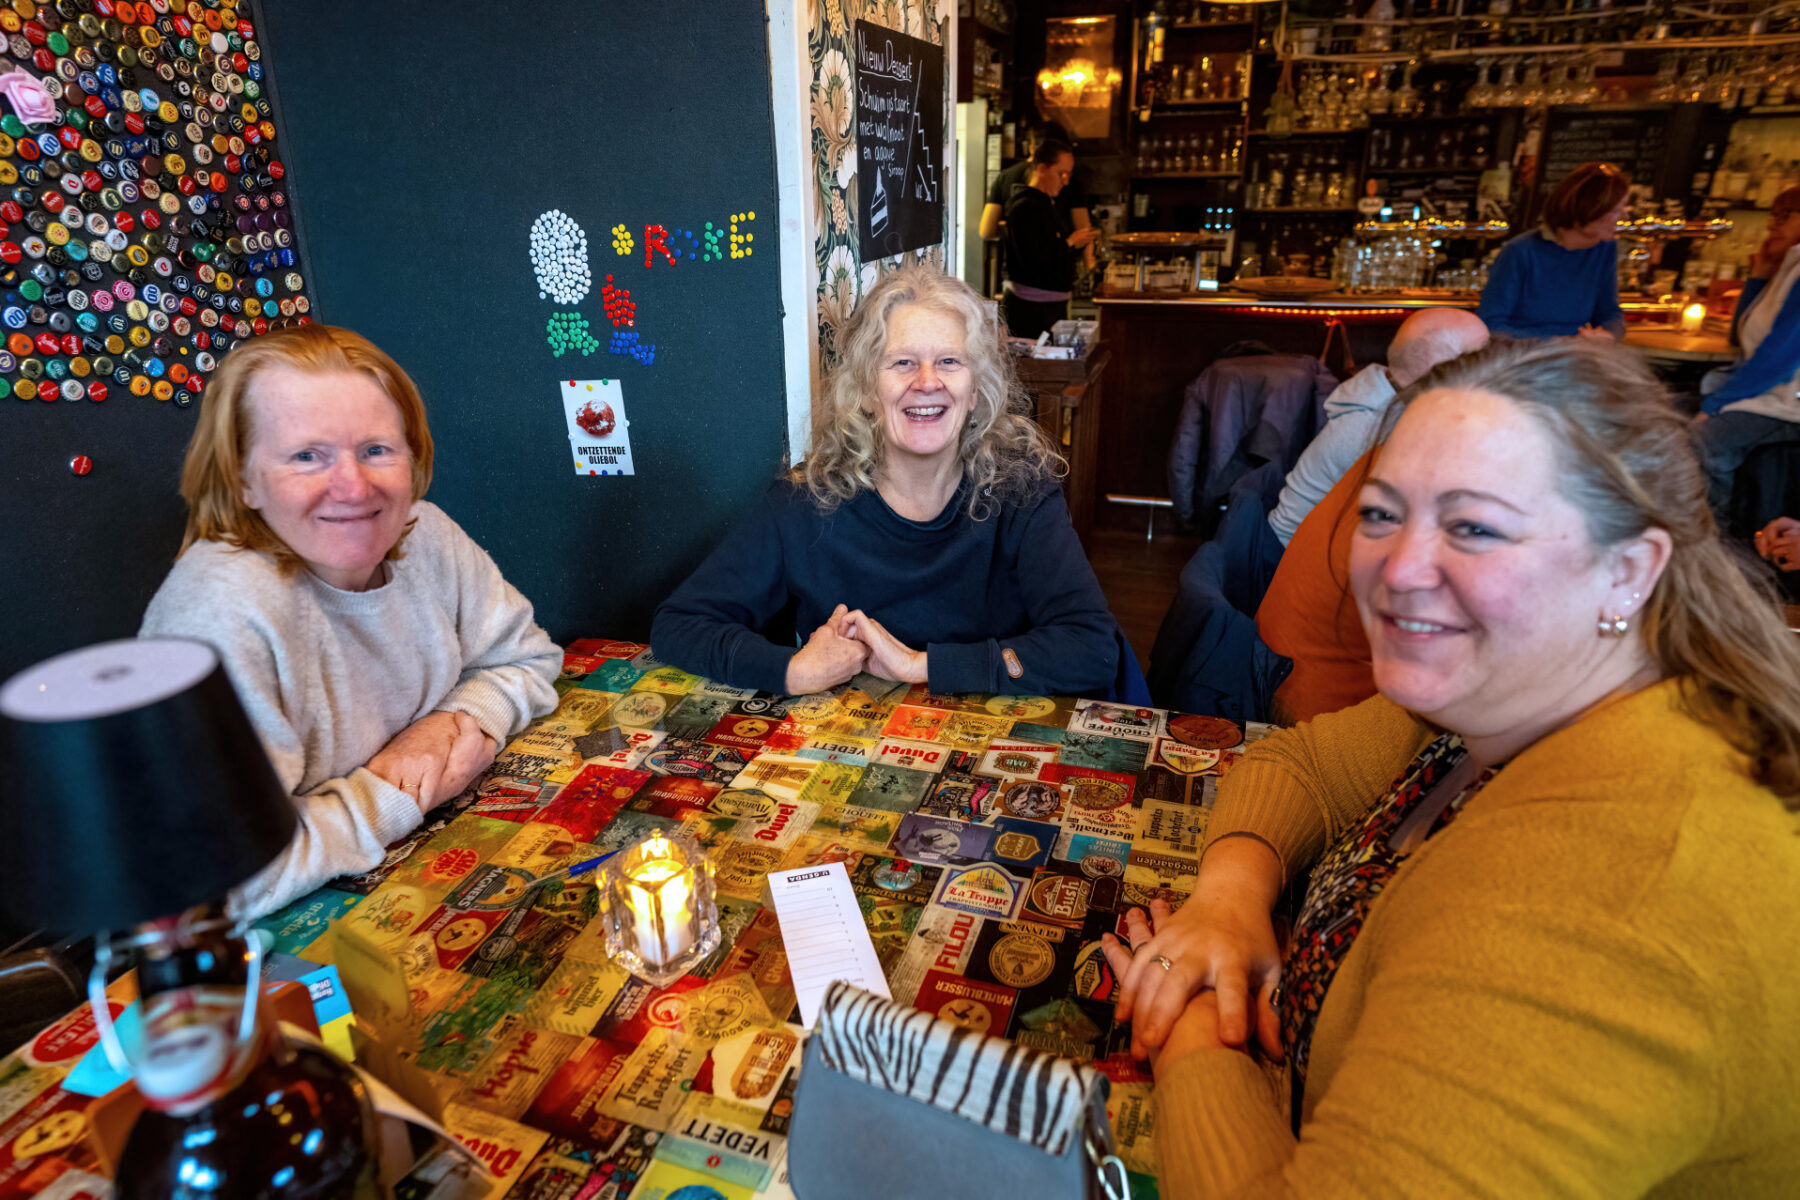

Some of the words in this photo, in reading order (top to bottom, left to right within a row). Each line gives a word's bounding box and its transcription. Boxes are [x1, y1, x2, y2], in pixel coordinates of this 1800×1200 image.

[858, 28, 884, 73] Nieuw
[885, 39, 912, 80] Dessert
[859, 115, 875, 136] met
[875, 118, 905, 143] walnoot
[863, 146, 872, 161] en
[874, 146, 896, 170] agave
[577, 446, 626, 456] ONTZETTENDE
[588, 455, 619, 465] OLIEBOL
[809, 741, 866, 757] VEDETT
[882, 744, 941, 763] Duvel
[754, 803, 798, 842] Duvel
[1068, 823, 1135, 841] Westmalle
[458, 866, 504, 907] MAGNERS
[852, 884, 928, 904] MAREDSOU
[948, 885, 966, 898] La
[966, 888, 1010, 907] Trappe
[1053, 880, 1080, 918] Bush
[934, 912, 976, 971] FILOU
[1002, 920, 1059, 939] GUINNESS
[935, 978, 1014, 1008] MANEBLUSSER
[681, 1118, 771, 1160] VEDETT
